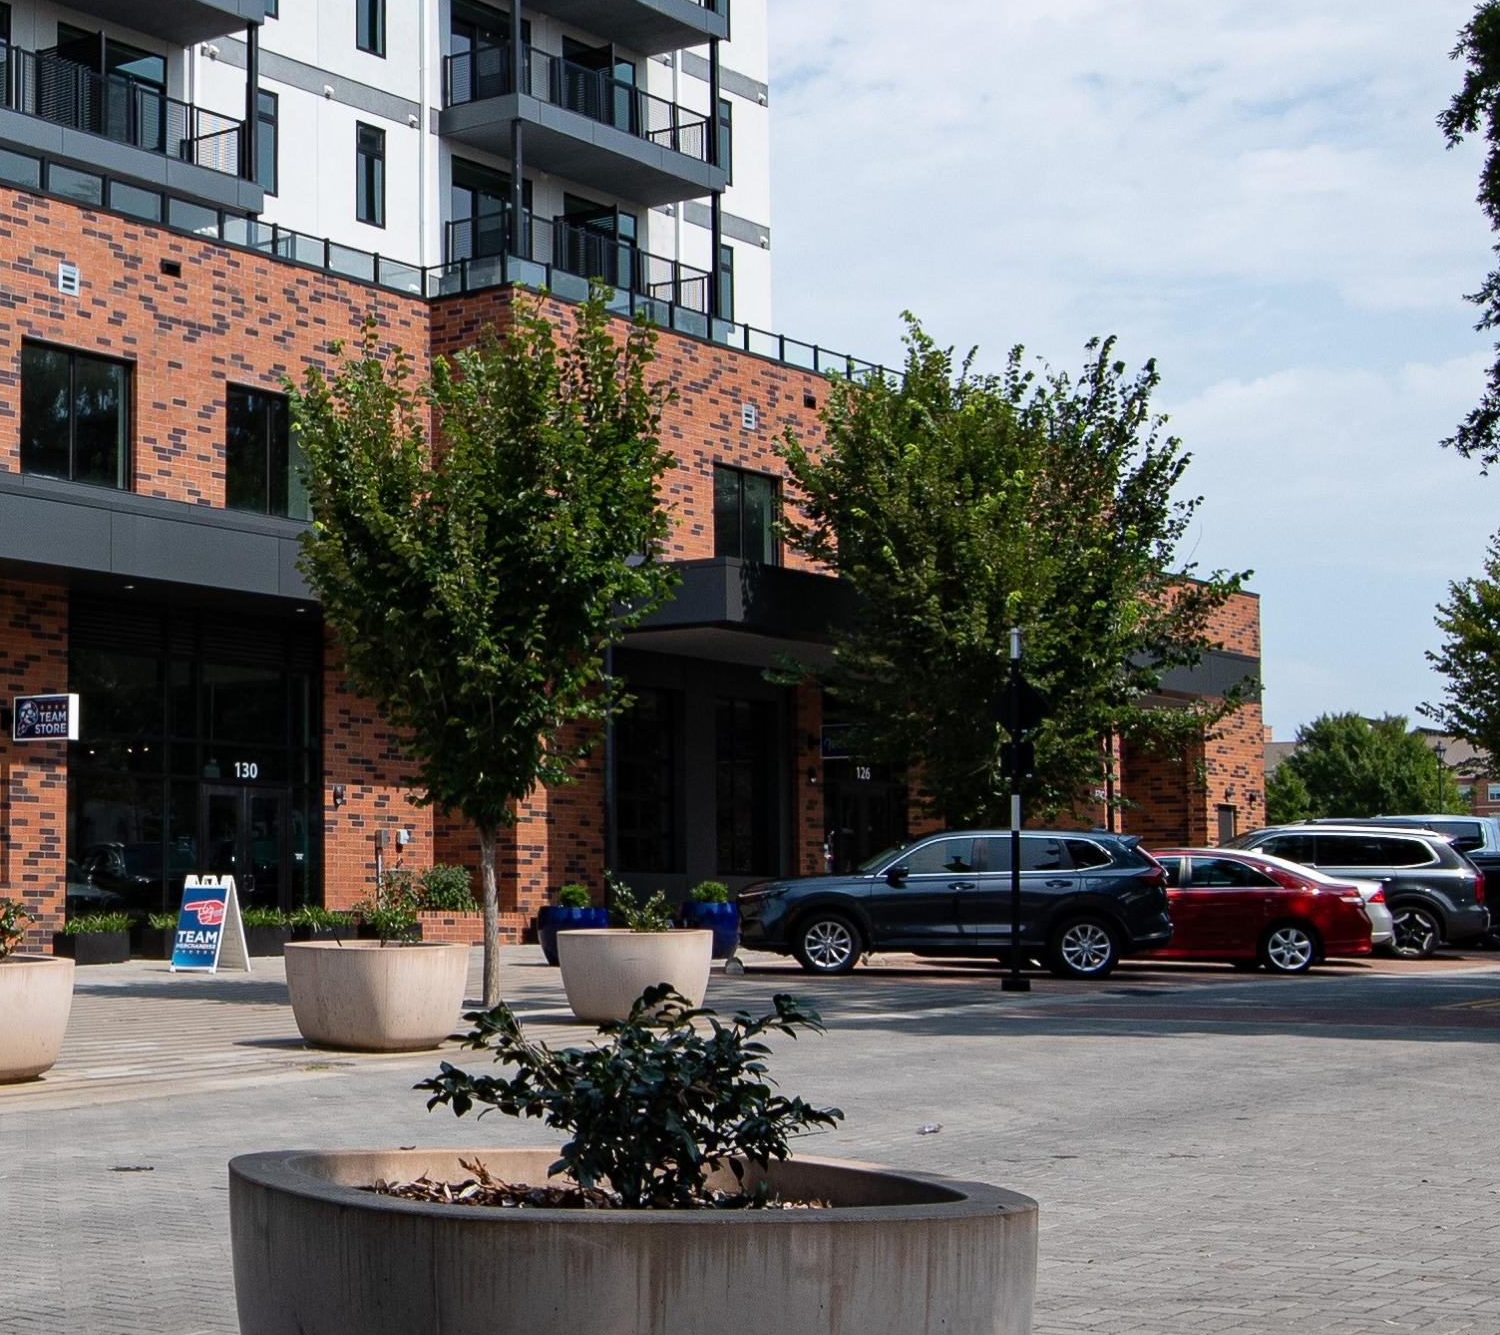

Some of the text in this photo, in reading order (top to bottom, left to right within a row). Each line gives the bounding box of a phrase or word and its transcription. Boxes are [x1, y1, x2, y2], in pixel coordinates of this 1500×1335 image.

[40, 711, 67, 722] TEAM
[35, 723, 67, 734] STORE
[234, 761, 258, 779] 130
[856, 766, 871, 780] 126
[178, 930, 218, 943] TEAM
